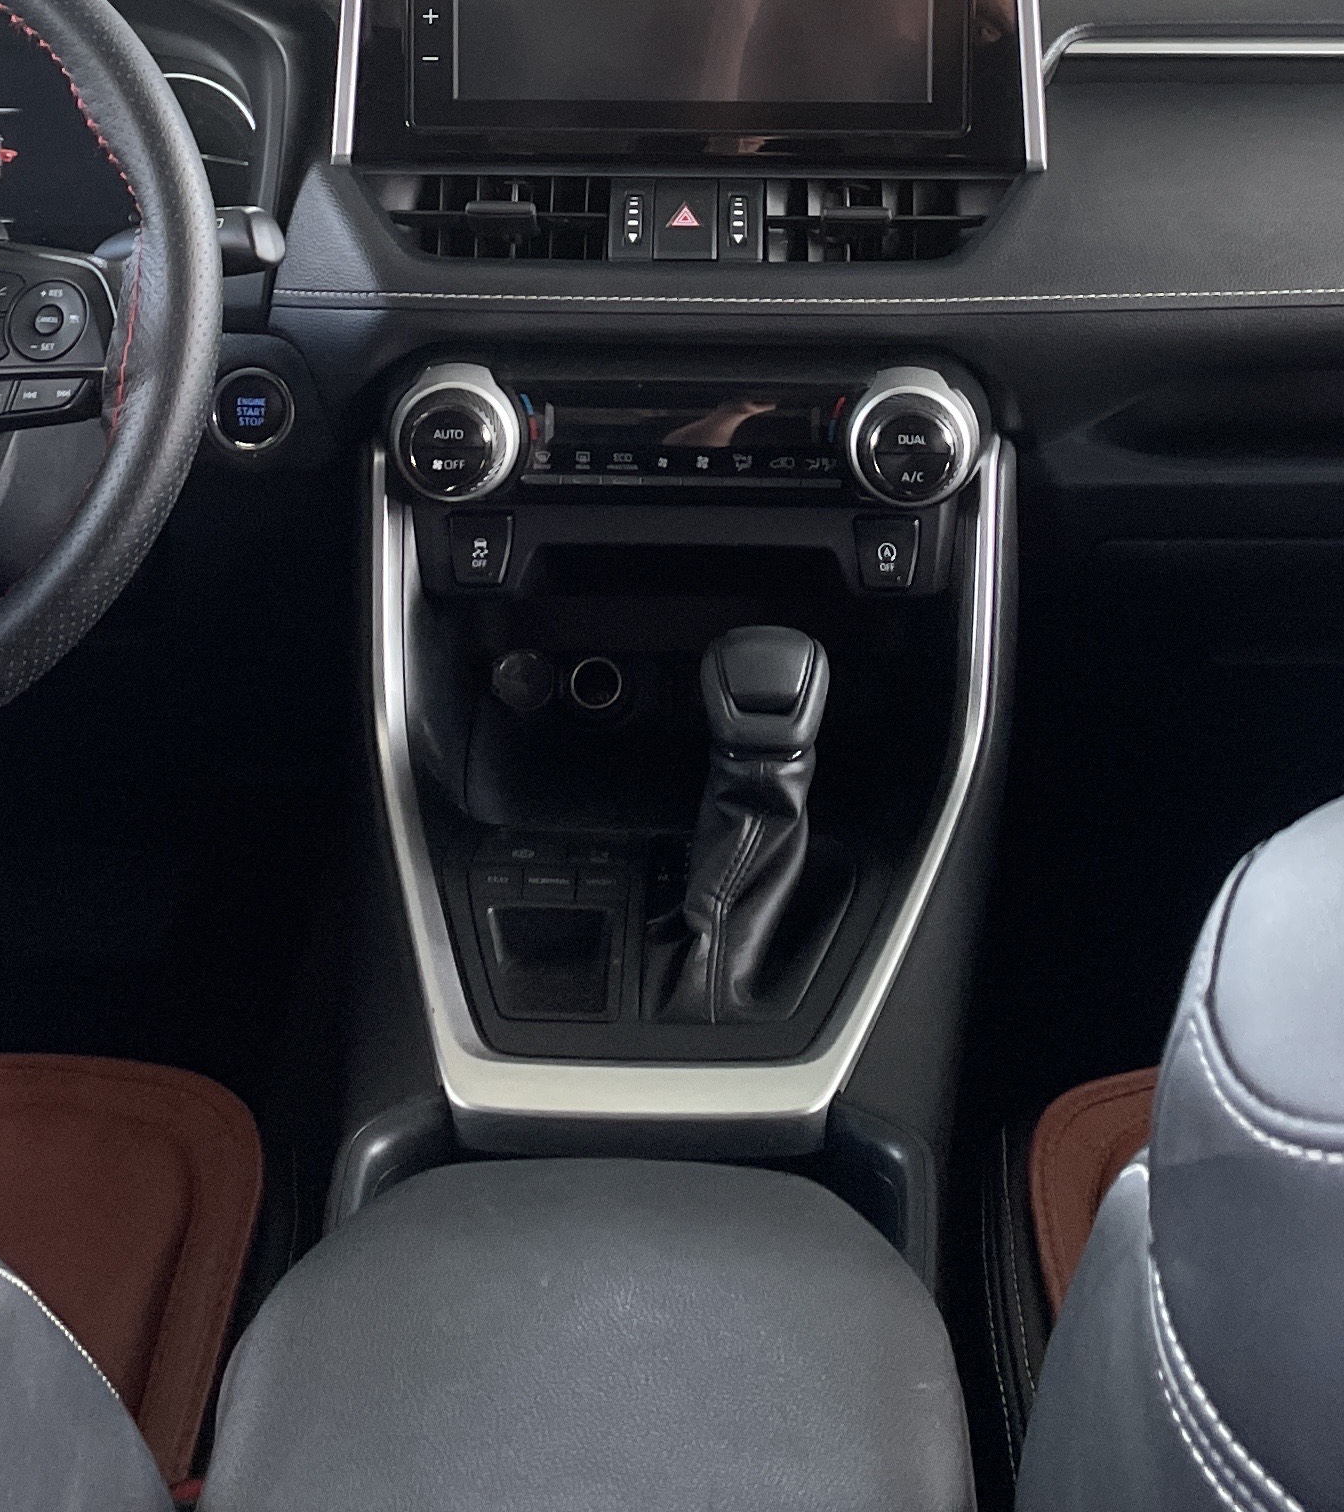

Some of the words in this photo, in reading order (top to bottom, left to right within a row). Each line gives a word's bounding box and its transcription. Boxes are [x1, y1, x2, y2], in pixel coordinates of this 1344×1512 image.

[236, 407, 265, 416] START
[239, 417, 264, 426] STOP
[433, 429, 464, 440] AUTO
[897, 434, 927, 445] DUAL
[444, 459, 466, 470] OFF
[901, 471, 925, 483] A/C
